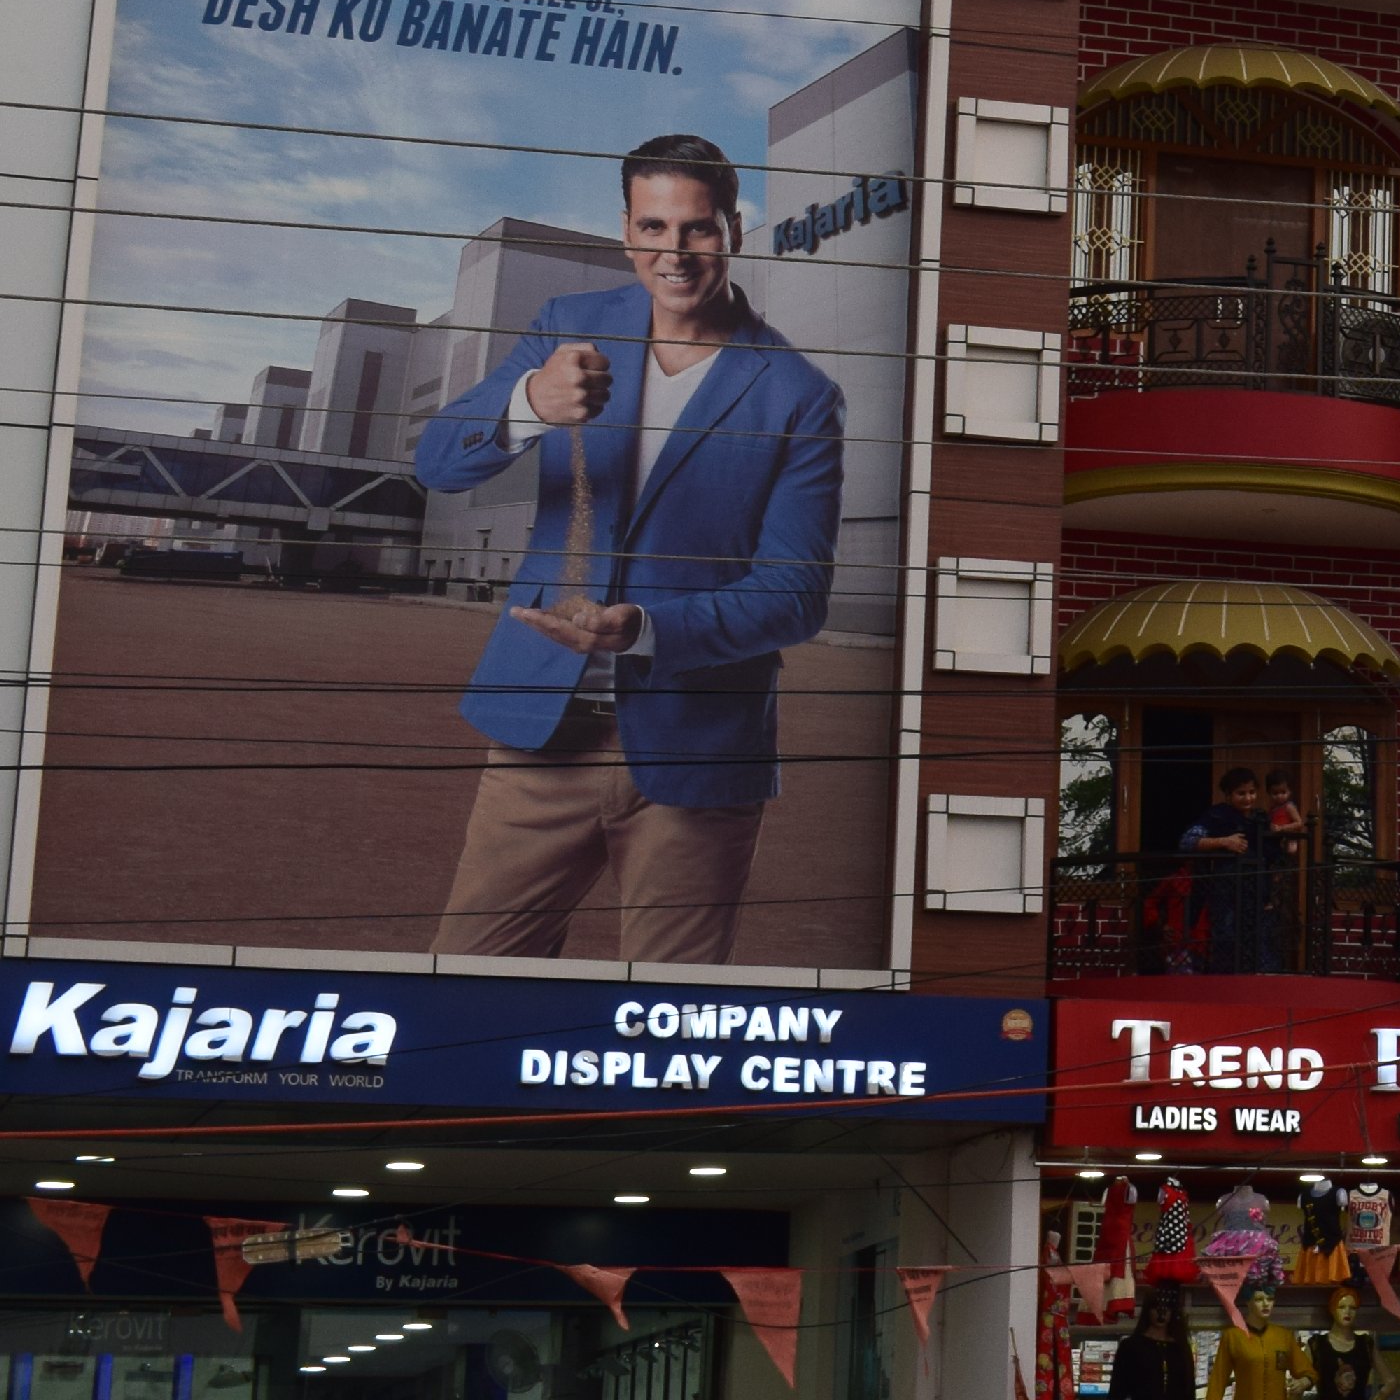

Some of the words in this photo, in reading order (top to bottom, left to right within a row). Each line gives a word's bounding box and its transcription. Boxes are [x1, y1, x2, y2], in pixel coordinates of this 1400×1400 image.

[573, 18, 684, 77] HAIN.
[772, 169, 908, 256] Kajaria
[9, 981, 398, 1080] Kajaria
[614, 1001, 843, 1044] COMPANY
[519, 1048, 722, 1090] DISPLAY
[740, 1055, 927, 1096] CENTRE
[1111, 1018, 1325, 1091] TREND
[176, 1069, 268, 1086] TRANSFORM
[279, 1072, 319, 1087] YOUR
[329, 1074, 384, 1089] WORLD
[1135, 1105, 1218, 1133] LADIES
[1234, 1108, 1302, 1134] WEAR
[375, 1276, 393, 1292] By
[398, 1274, 458, 1291] Kajaria
